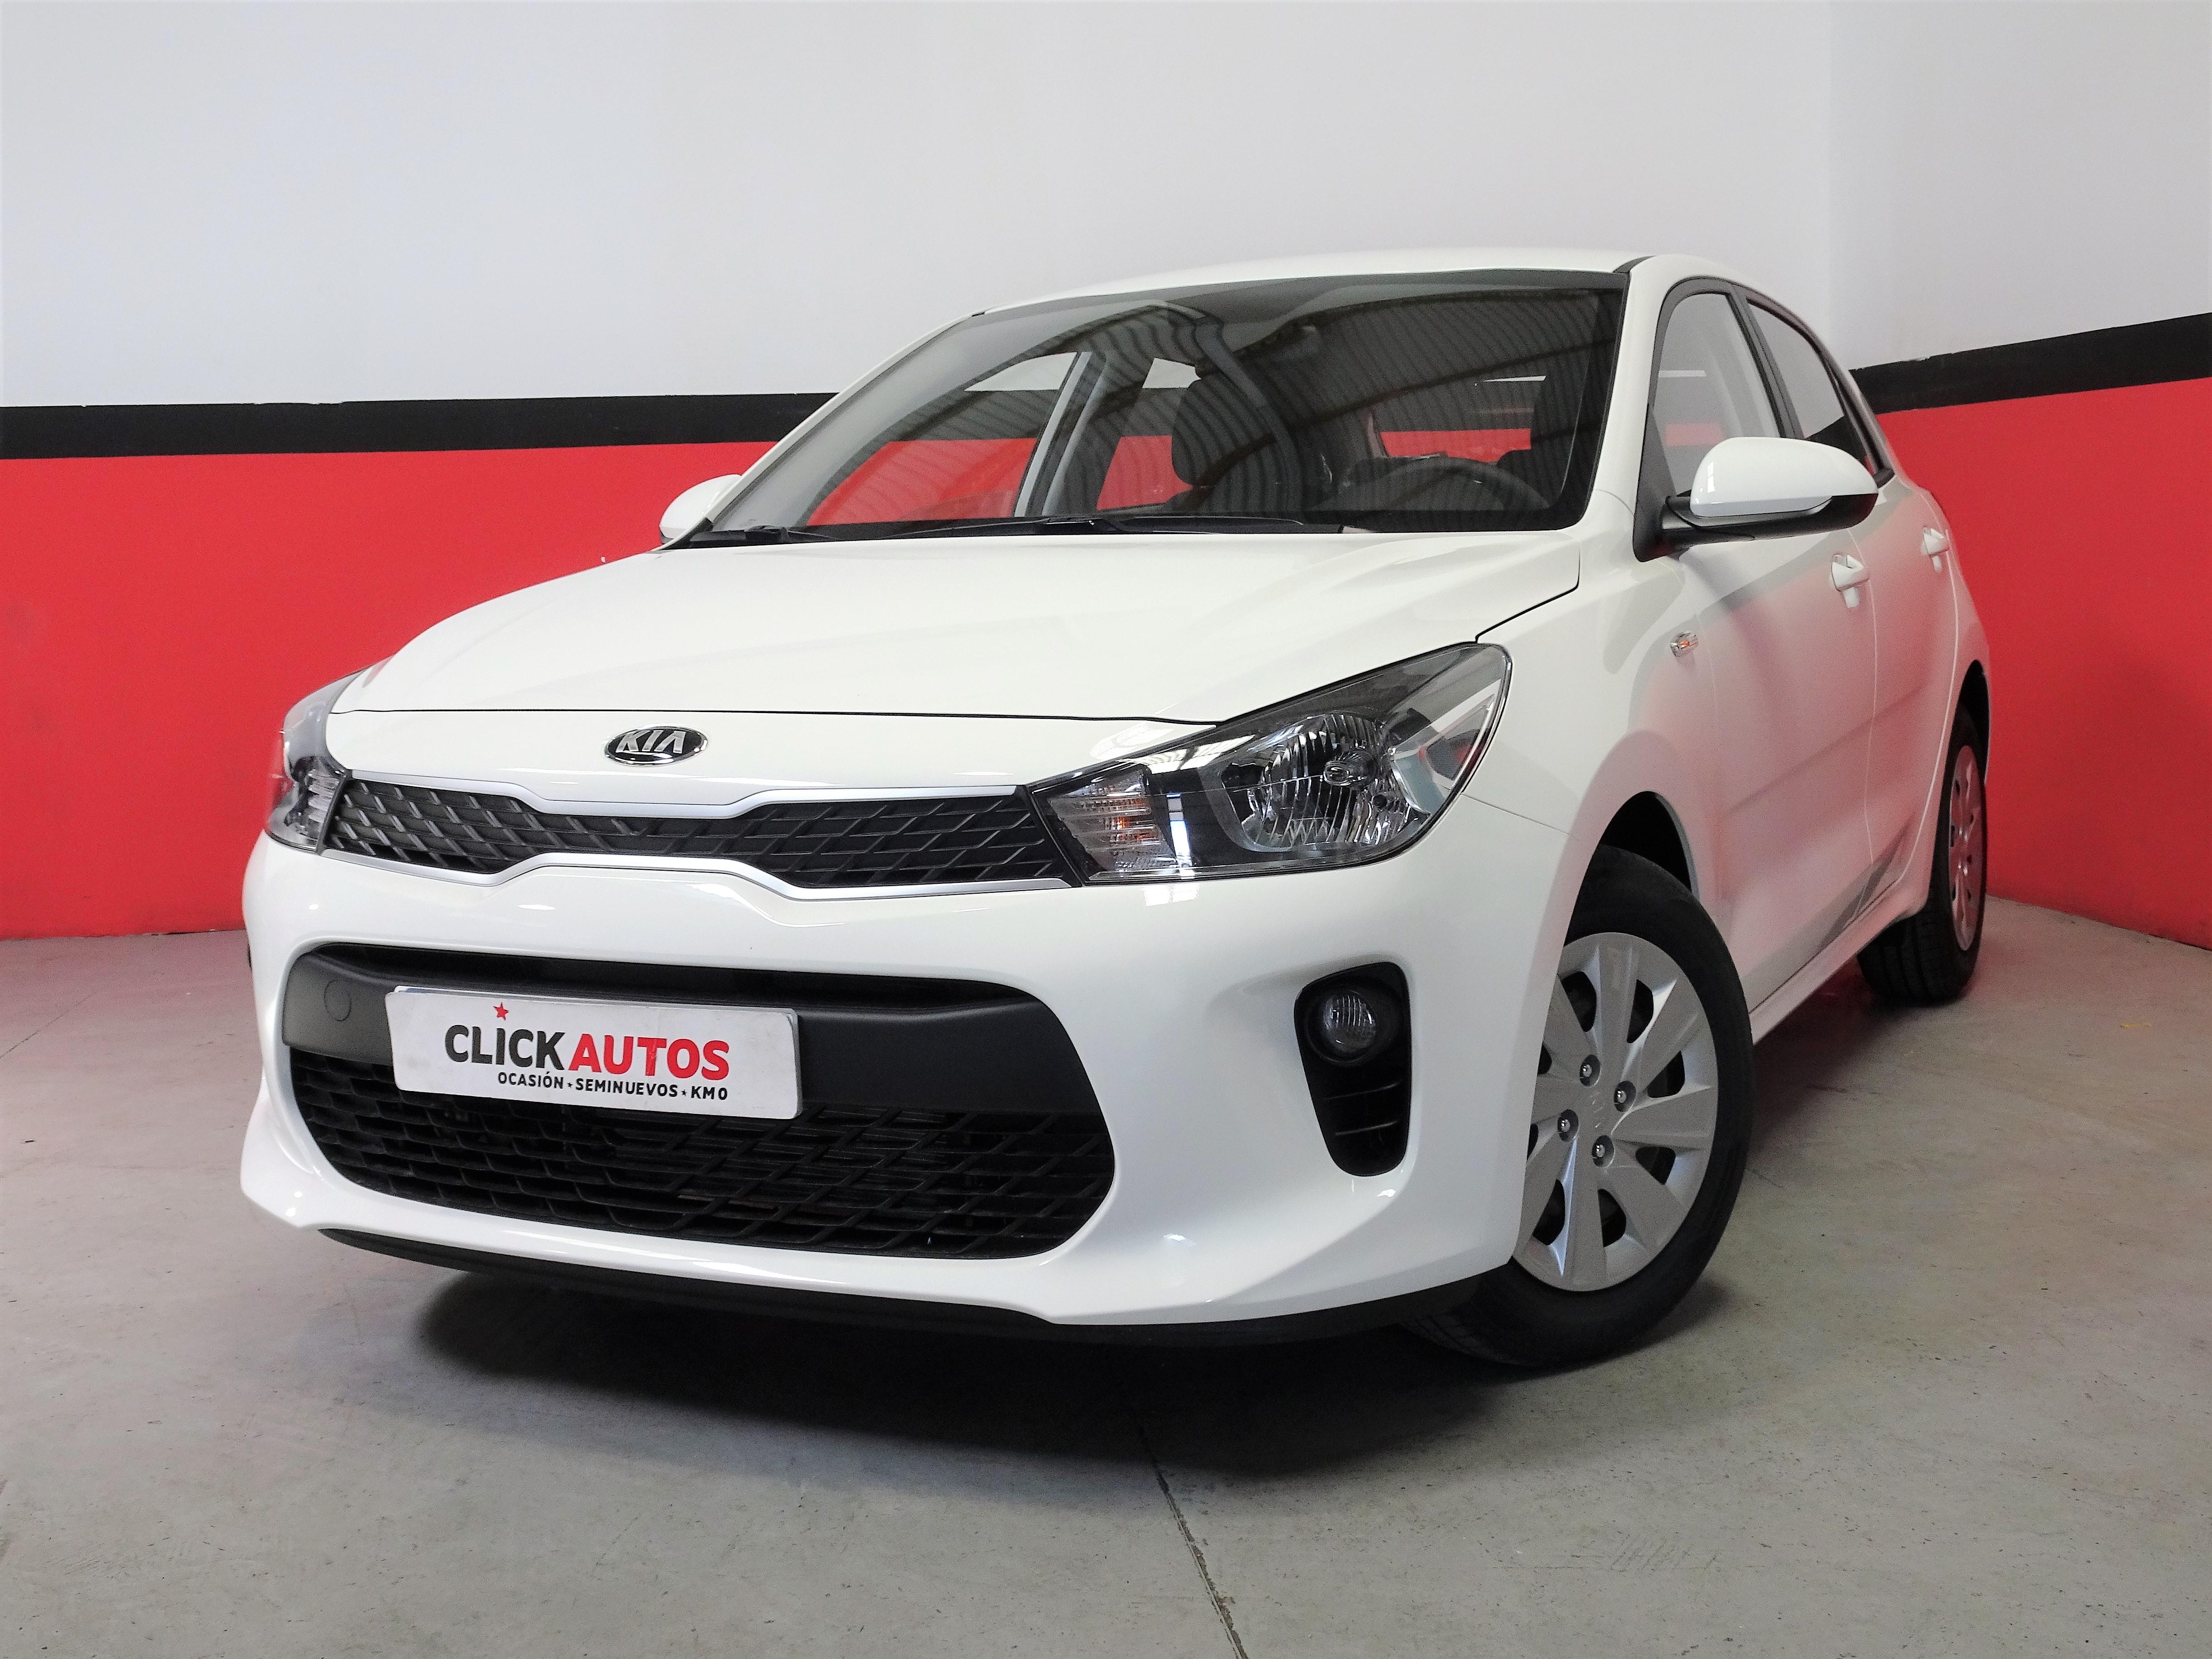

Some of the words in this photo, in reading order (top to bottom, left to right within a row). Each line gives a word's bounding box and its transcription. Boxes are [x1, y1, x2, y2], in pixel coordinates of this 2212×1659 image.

[615, 730, 686, 754] KIA
[497, 1071, 564, 1089] OCASIÓN
[575, 1078, 678, 1098] SEMINUEVOS
